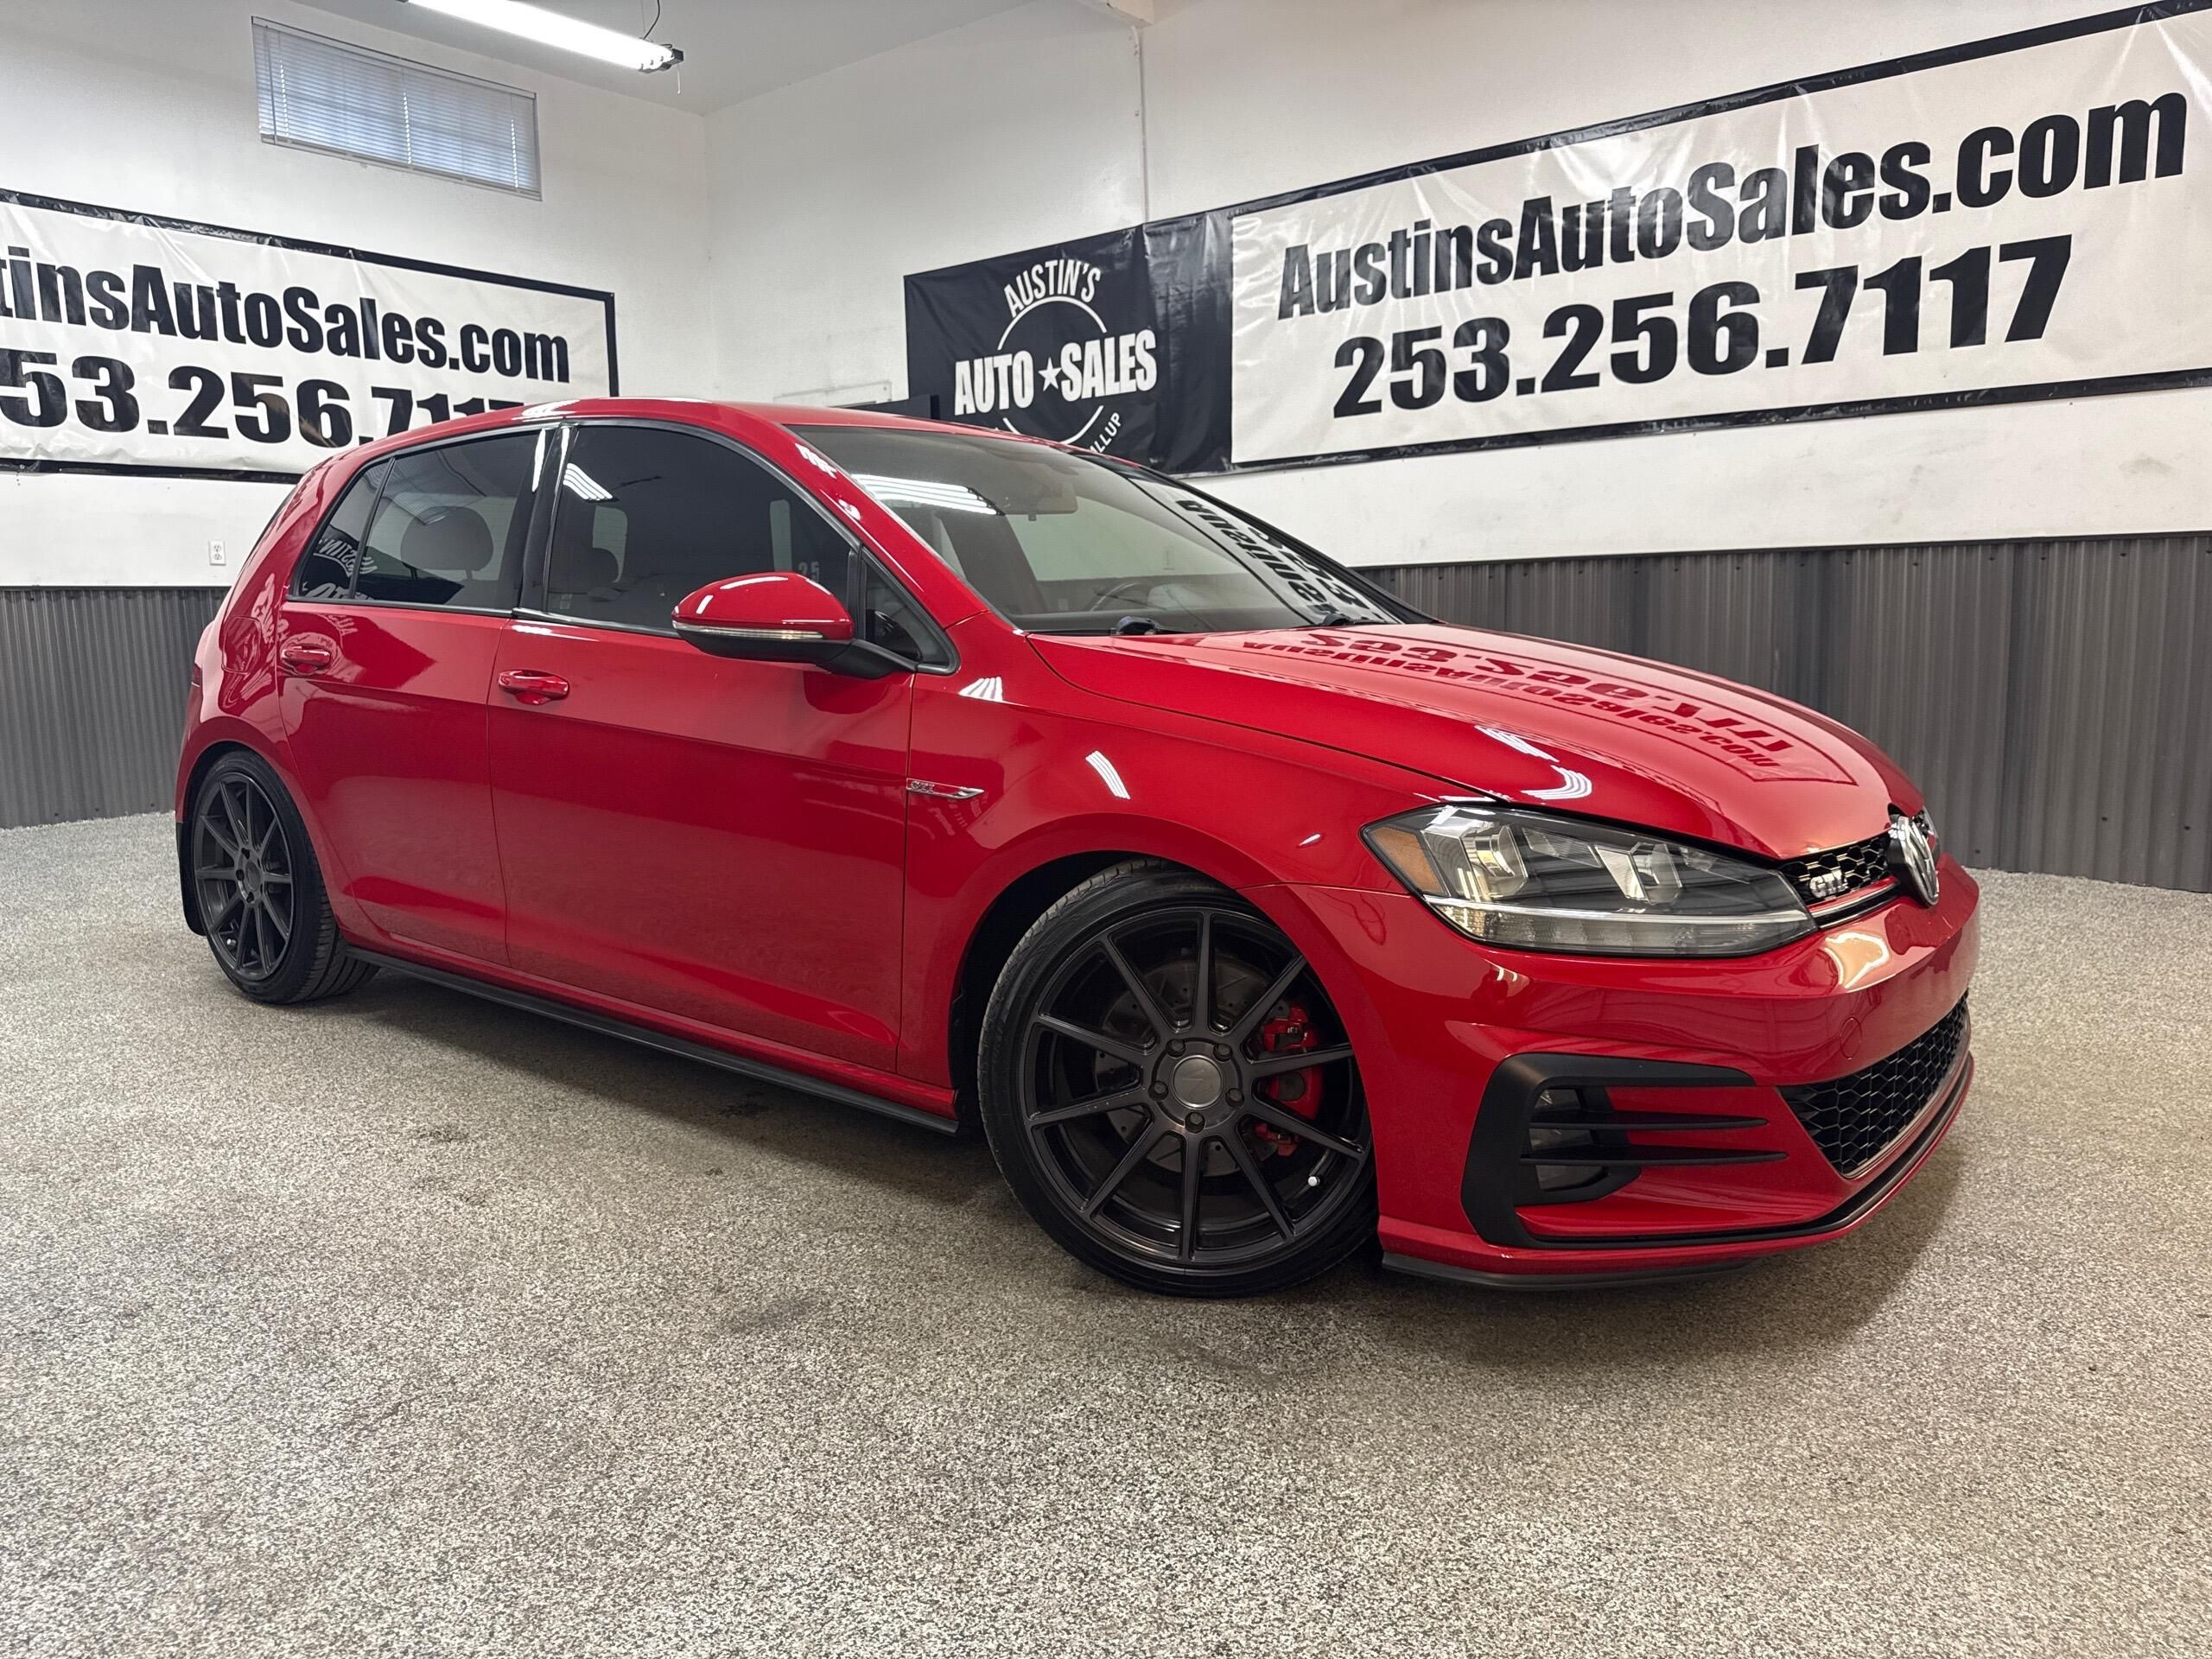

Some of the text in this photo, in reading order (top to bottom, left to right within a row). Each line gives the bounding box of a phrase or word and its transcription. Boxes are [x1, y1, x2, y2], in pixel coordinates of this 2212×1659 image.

[1277, 92, 2188, 320] AustinsAutoSales.com
[1003, 259, 1101, 317] AUSTIN'S
[1332, 235, 2073, 418] 253.256.7117
[955, 329, 1157, 416] AUTO SALES
